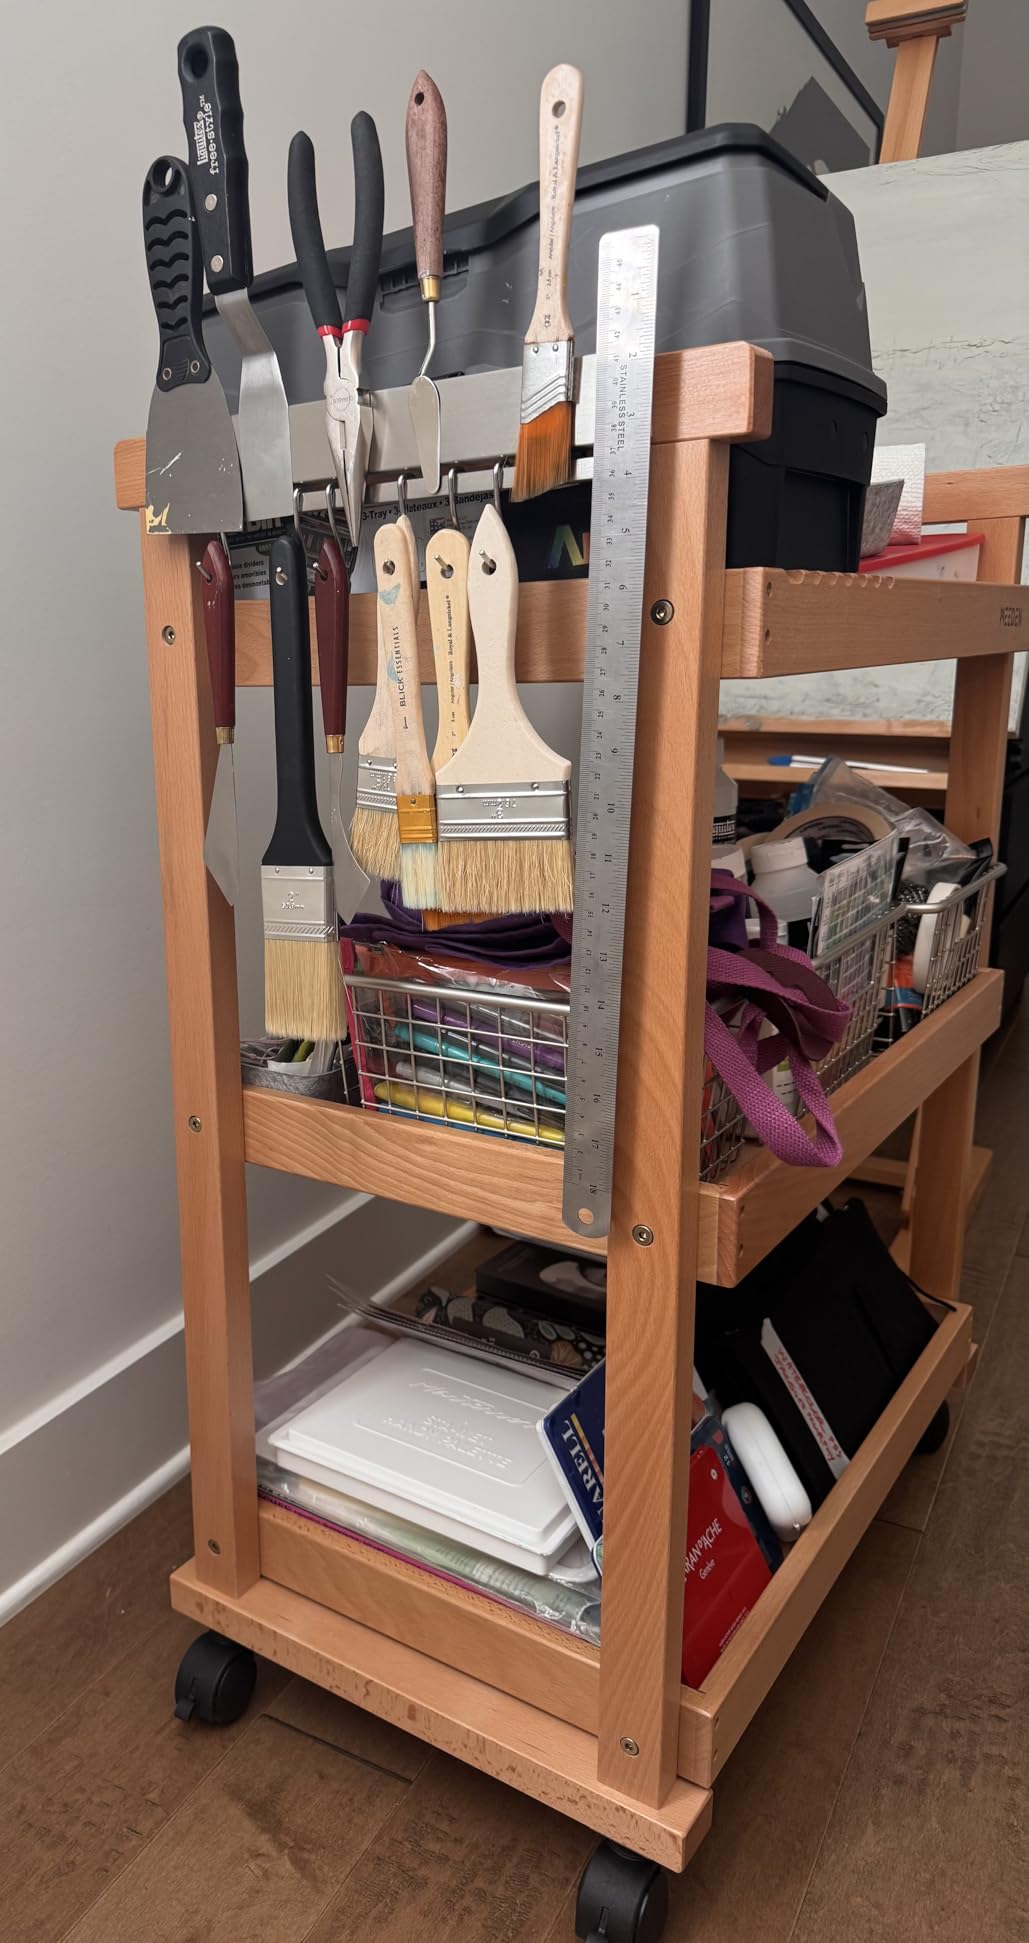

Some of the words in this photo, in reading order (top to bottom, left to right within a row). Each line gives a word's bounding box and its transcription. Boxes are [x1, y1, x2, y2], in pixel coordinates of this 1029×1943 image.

[619, 364, 627, 418] STAINLESS
[617, 422, 625, 452] STEEL
[393, 502, 438, 516] 3-lateaux
[393, 626, 403, 674] ESSENTIALS
[397, 677, 406, 706] BLICK
